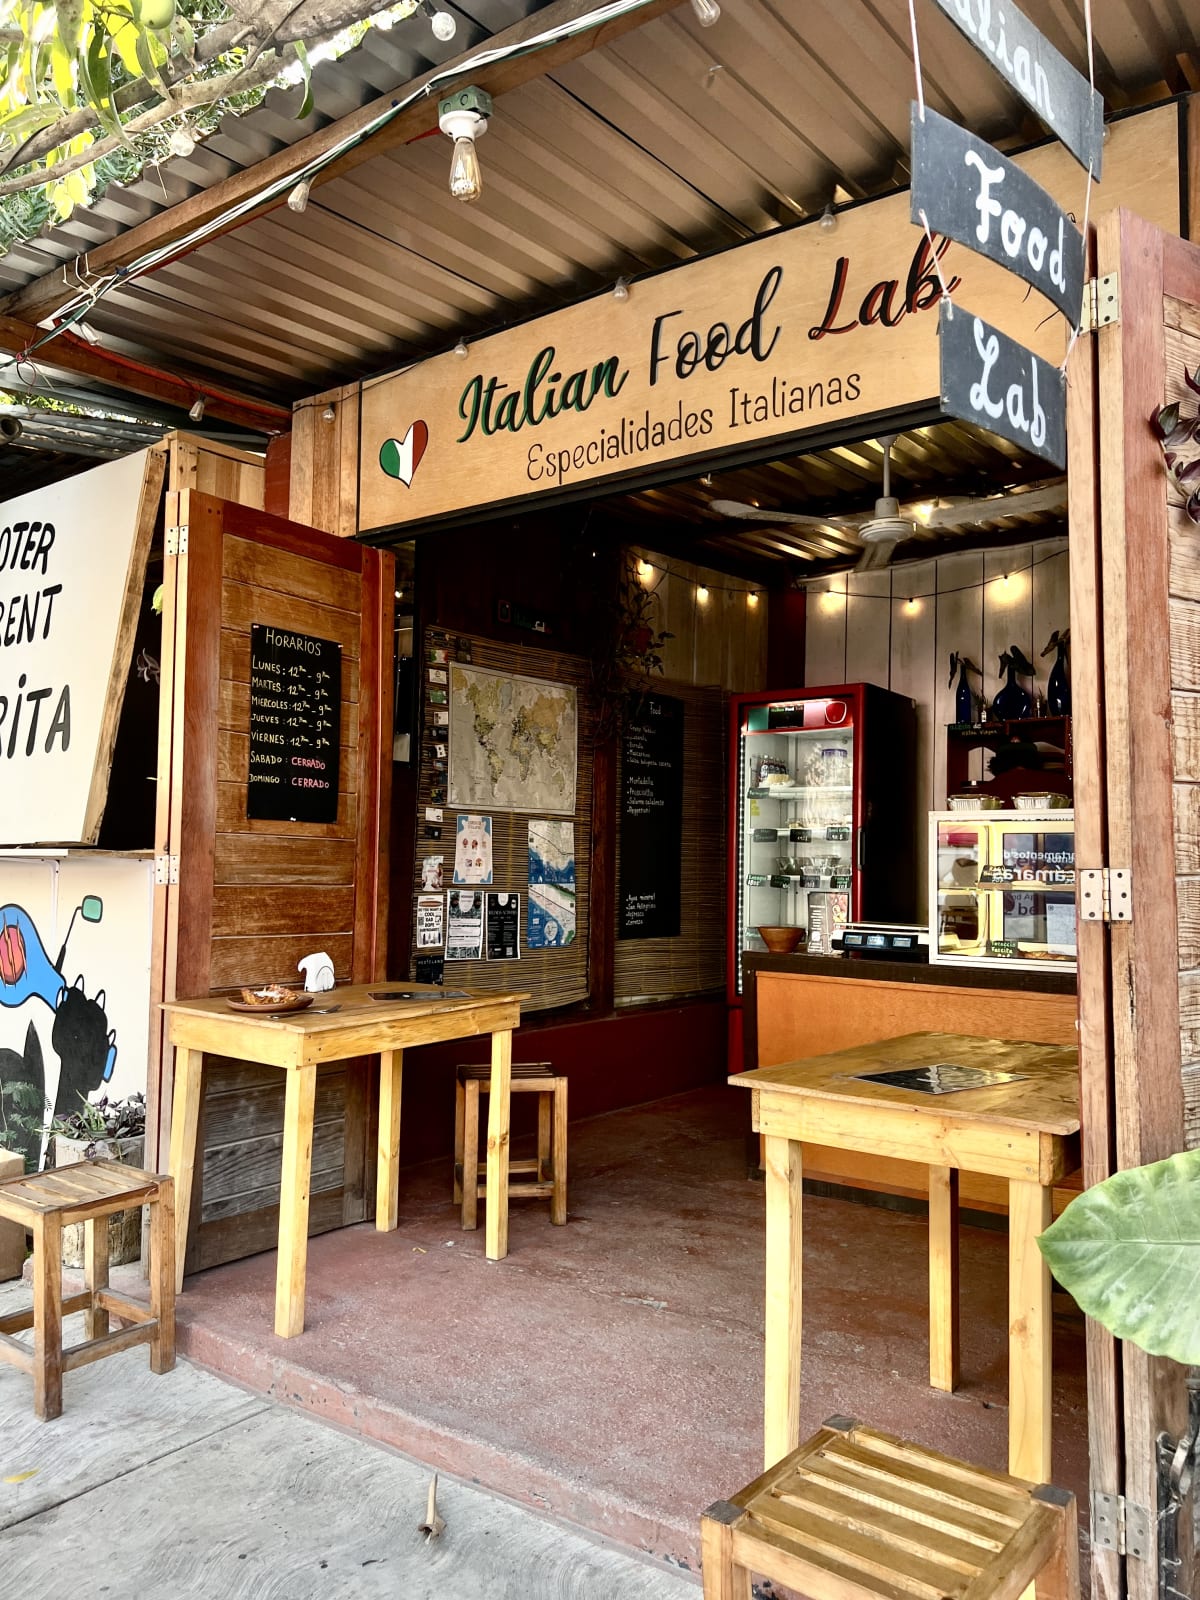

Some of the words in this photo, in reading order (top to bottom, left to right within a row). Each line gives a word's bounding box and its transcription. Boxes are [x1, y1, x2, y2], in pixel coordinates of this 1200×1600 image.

[946, 0, 1055, 121] alian
[964, 150, 1066, 294] Food
[456, 345, 629, 444] Italian
[649, 265, 783, 386] Food
[807, 230, 962, 341] Lab
[969, 317, 1046, 448] Lab
[527, 400, 713, 485] Especialidades
[729, 373, 861, 428] Italianas
[291, 756, 326, 770] CERRADO
[291, 776, 330, 789] CERRADO
